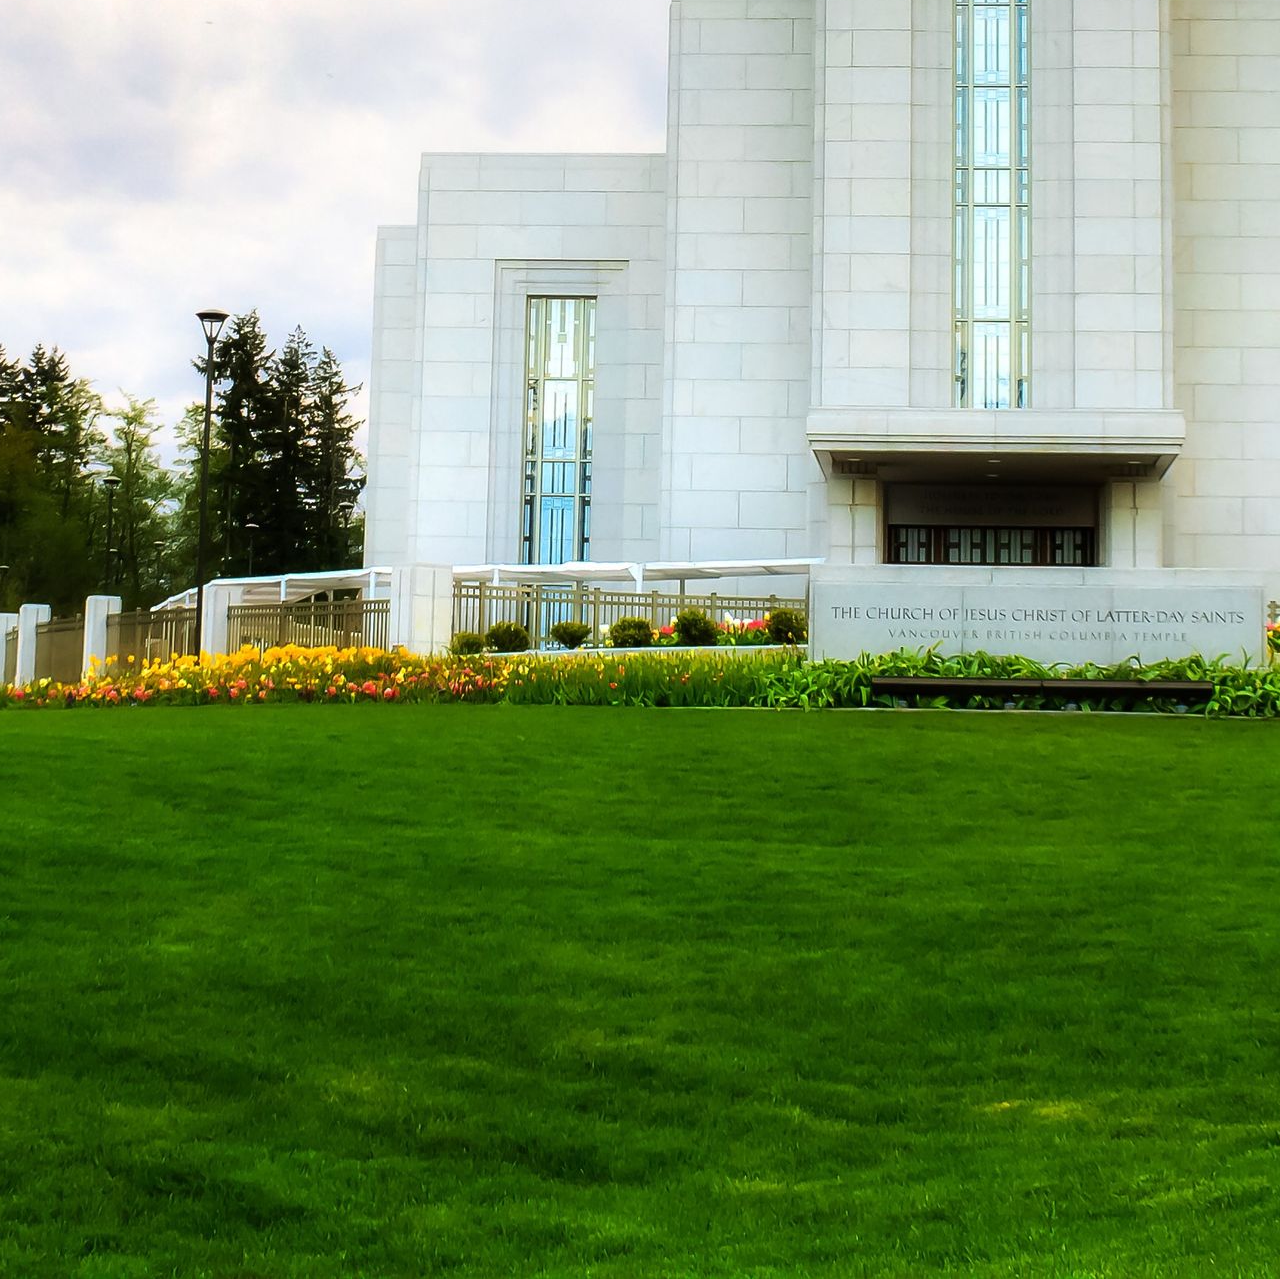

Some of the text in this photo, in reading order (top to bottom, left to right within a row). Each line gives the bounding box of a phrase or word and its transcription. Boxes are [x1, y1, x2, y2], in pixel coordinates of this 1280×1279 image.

[831, 606, 1245, 624] THE CHURCH OF JESUS CHRIST OF LATTER-DAY SAINTS
[887, 628, 1188, 642] VANCOUVER BRITISH COLUMBIA TEMPLE
